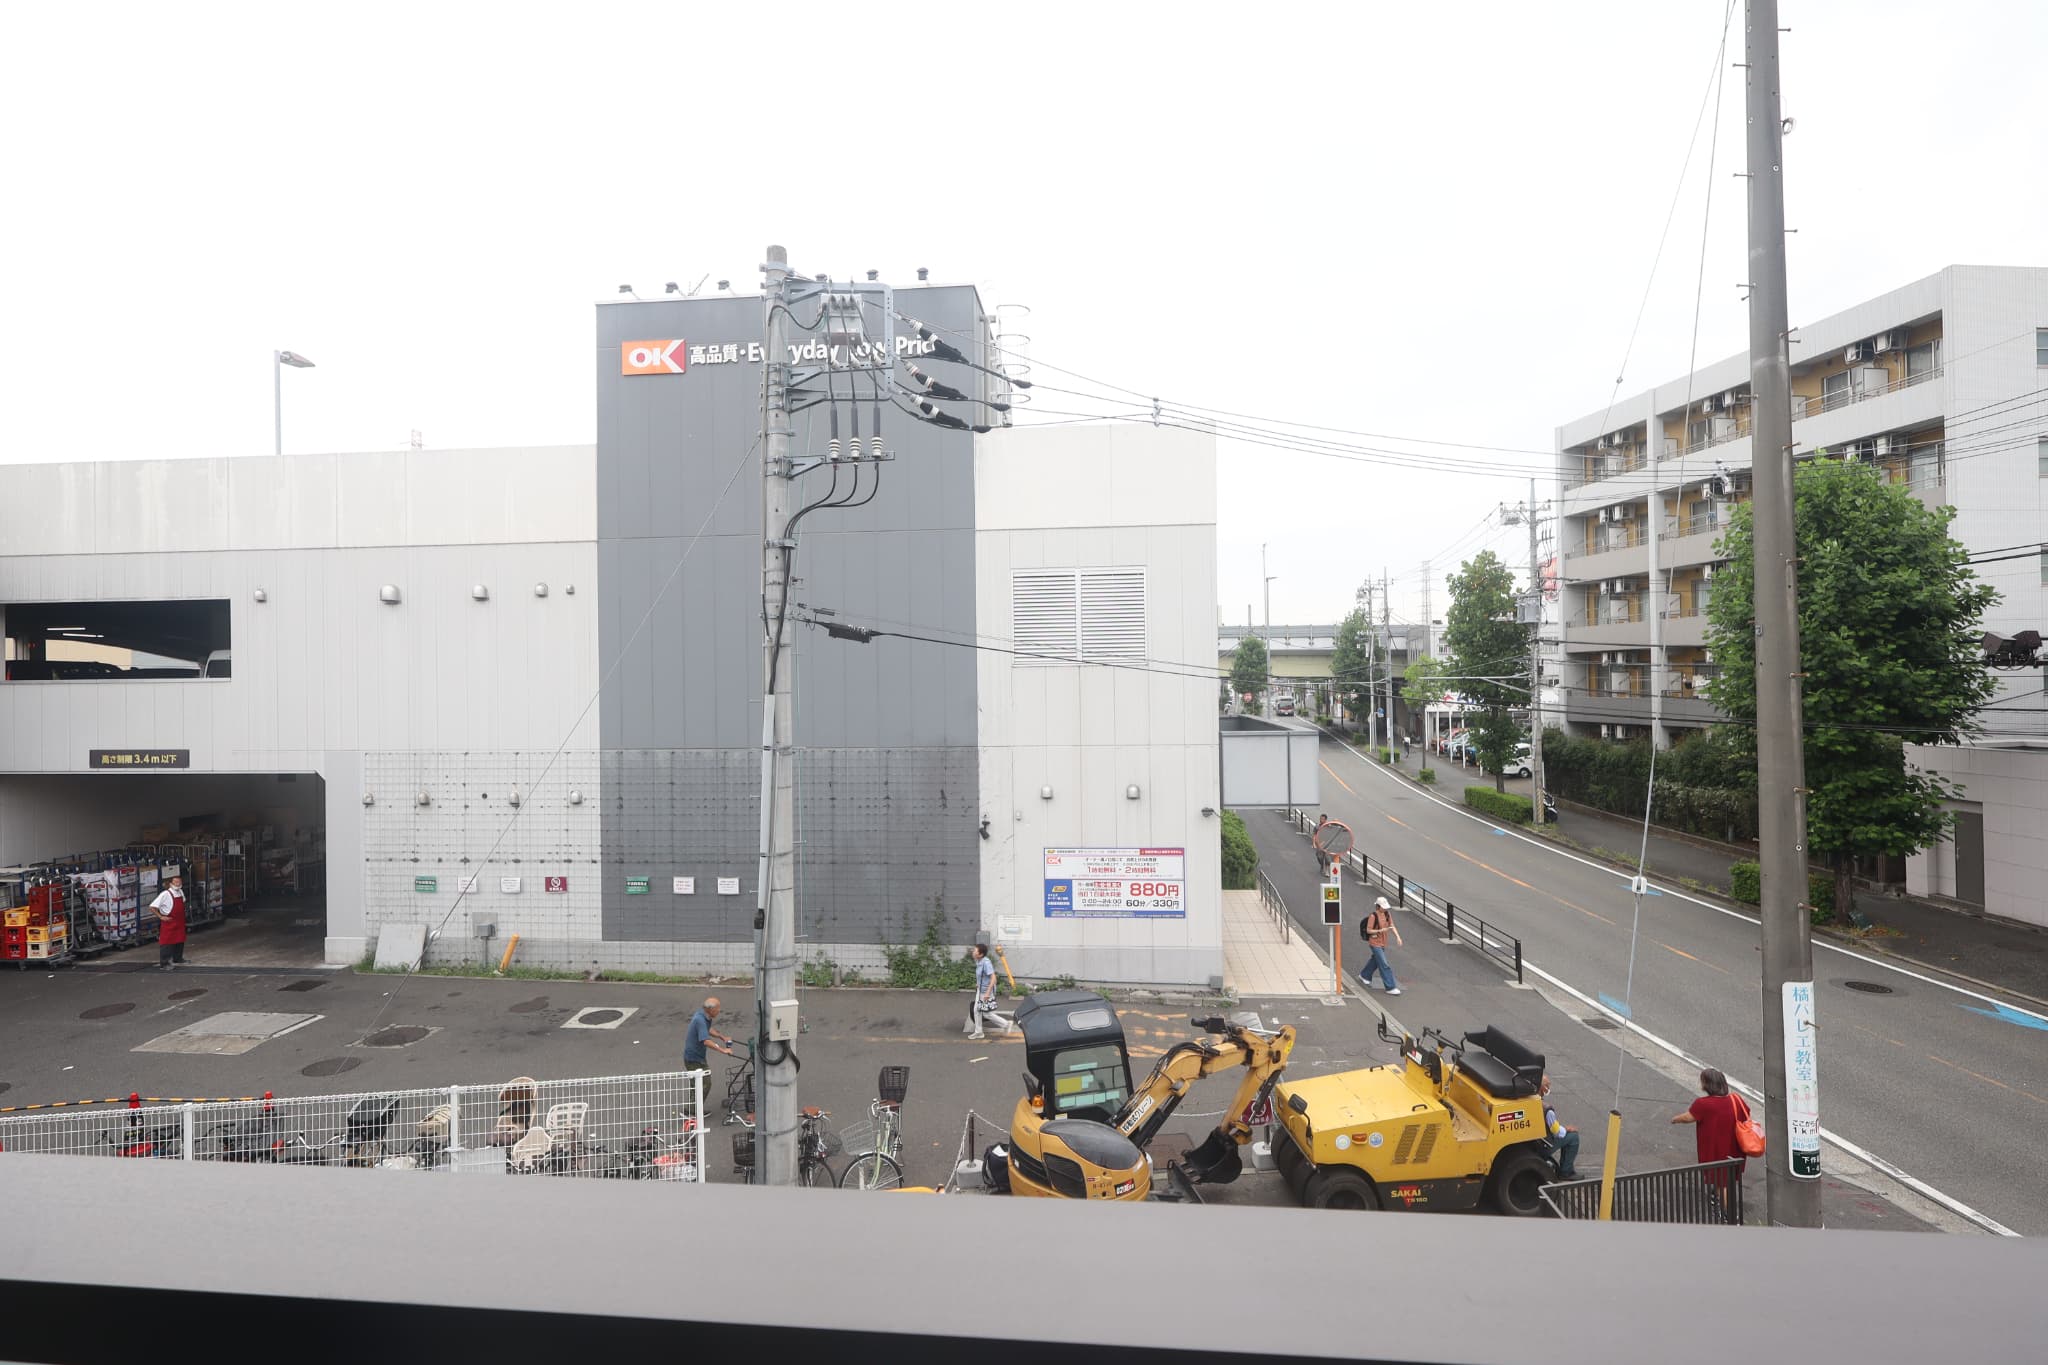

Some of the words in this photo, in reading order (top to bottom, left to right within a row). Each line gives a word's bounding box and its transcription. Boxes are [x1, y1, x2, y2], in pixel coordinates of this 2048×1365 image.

[895, 334, 936, 356] Pric
[628, 339, 686, 374] OK
[1130, 882, 1179, 896] 880円
[1499, 1119, 1532, 1133] R-1064
[1391, 1189, 1421, 1198] SAKAI
